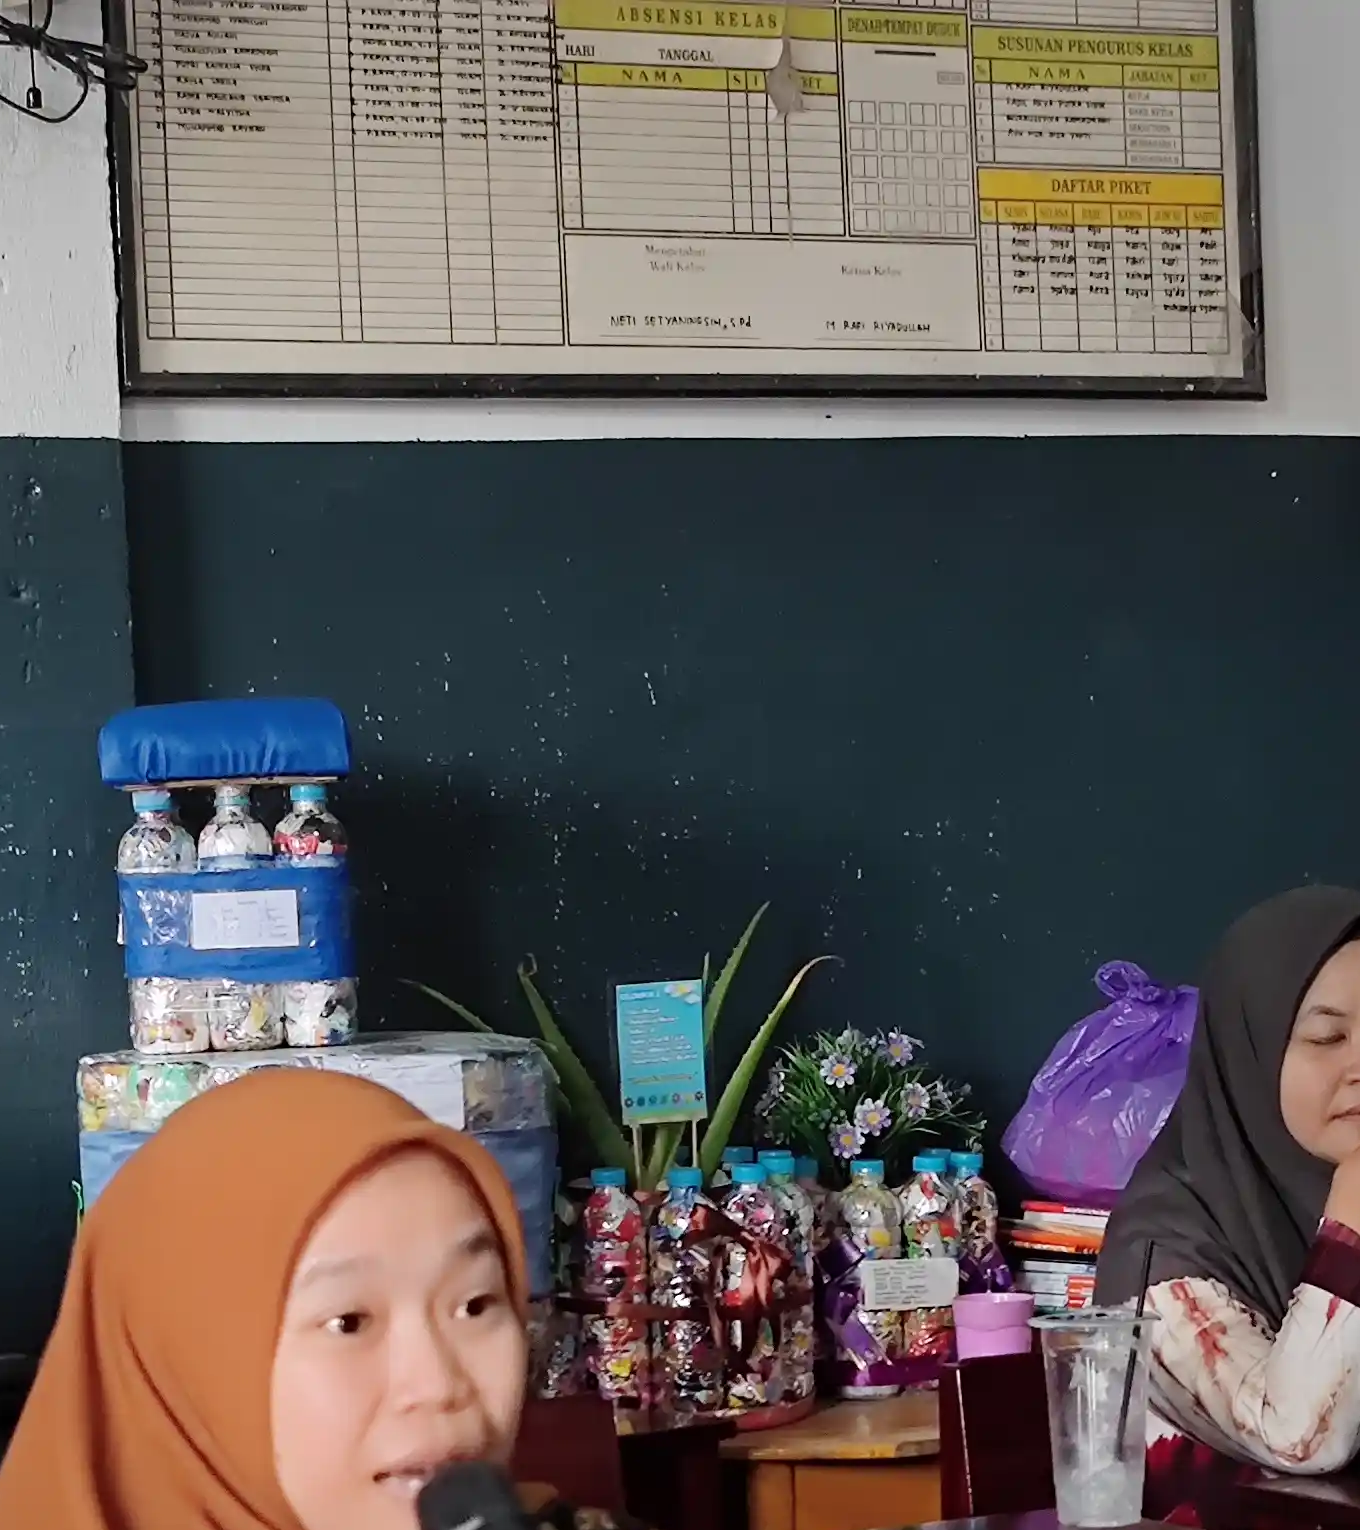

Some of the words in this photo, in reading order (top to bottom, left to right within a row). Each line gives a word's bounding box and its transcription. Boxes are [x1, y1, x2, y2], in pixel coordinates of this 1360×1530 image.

[616, 6, 704, 26] ABSENSI
[715, 11, 778, 29] KELAS
[565, 44, 596, 58] HARI
[998, 36, 1063, 52] SUSUNAN
[1068, 39, 1144, 57] PENGURUS
[1147, 42, 1193, 58] KELAS
[658, 48, 714, 63] TANGGAL
[1052, 178, 1105, 195] DAFTAR
[1110, 180, 1152, 195] PIKET
[610, 315, 637, 327] NETI
